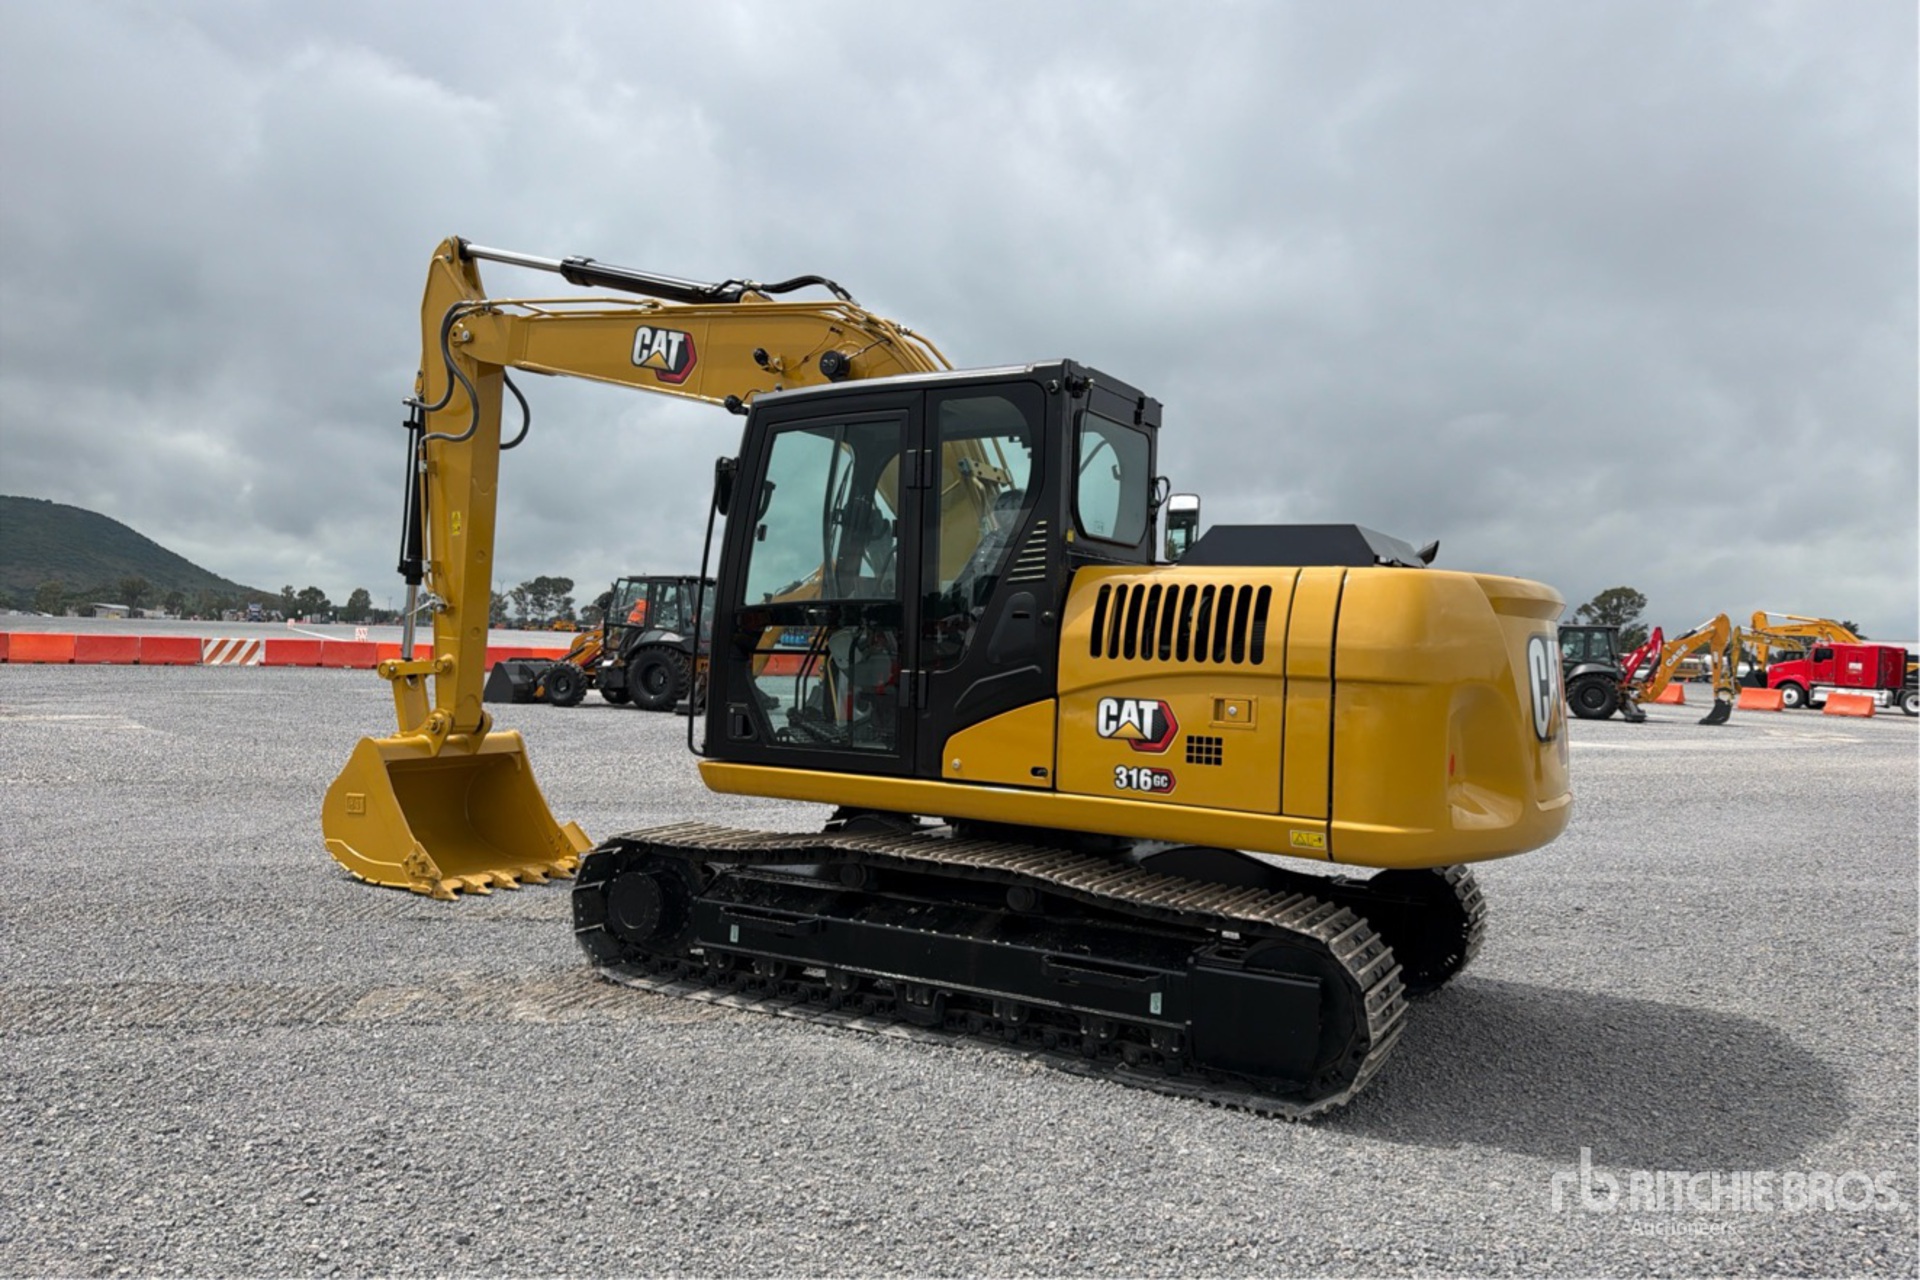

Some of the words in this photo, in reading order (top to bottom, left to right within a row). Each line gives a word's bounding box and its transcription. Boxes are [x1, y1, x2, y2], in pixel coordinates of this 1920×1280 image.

[632, 326, 686, 371] CAT
[1529, 637, 1561, 740] CA
[1097, 697, 1159, 741] CAT
